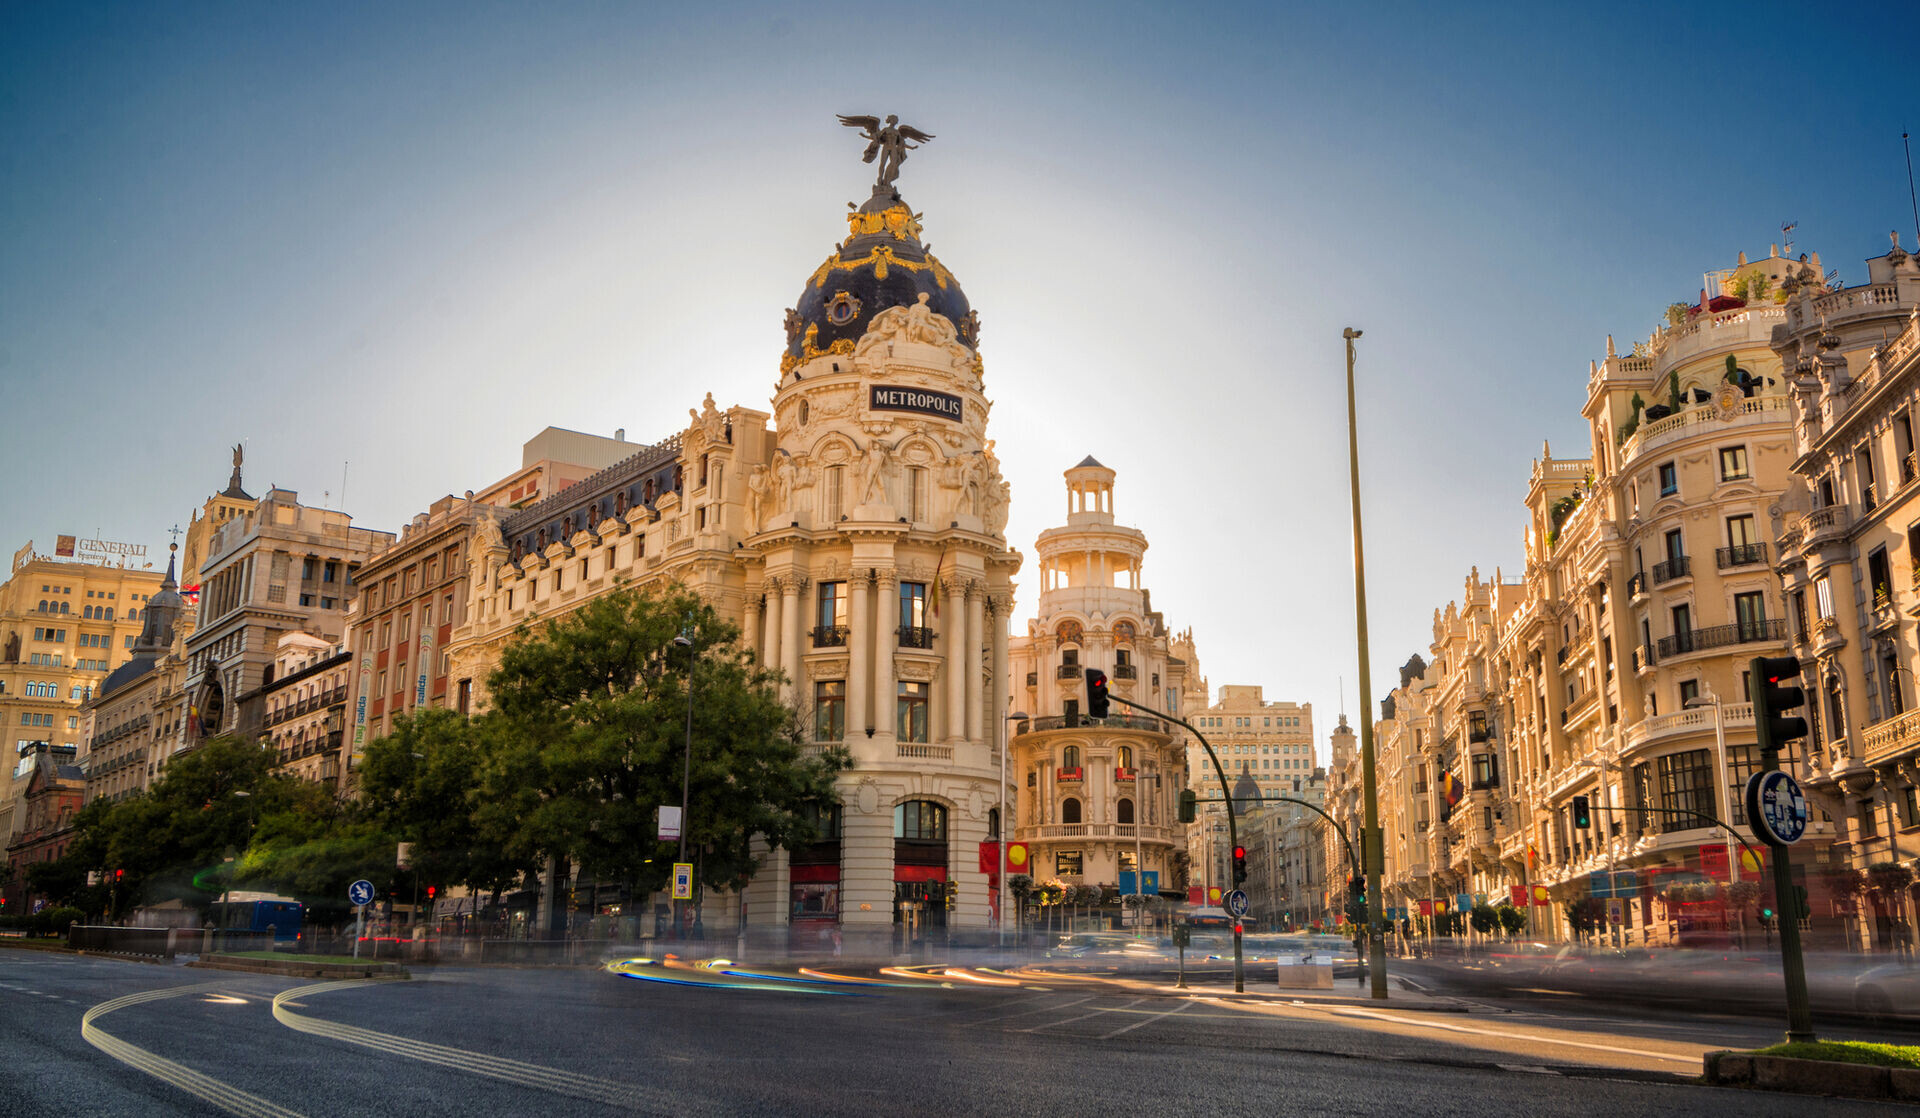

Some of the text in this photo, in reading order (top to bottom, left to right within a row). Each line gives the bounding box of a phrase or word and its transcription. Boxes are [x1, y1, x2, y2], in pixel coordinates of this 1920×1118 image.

[875, 390, 960, 415] METROPOLIS
[79, 539, 147, 557] GENERALI
[356, 696, 367, 724] salida
